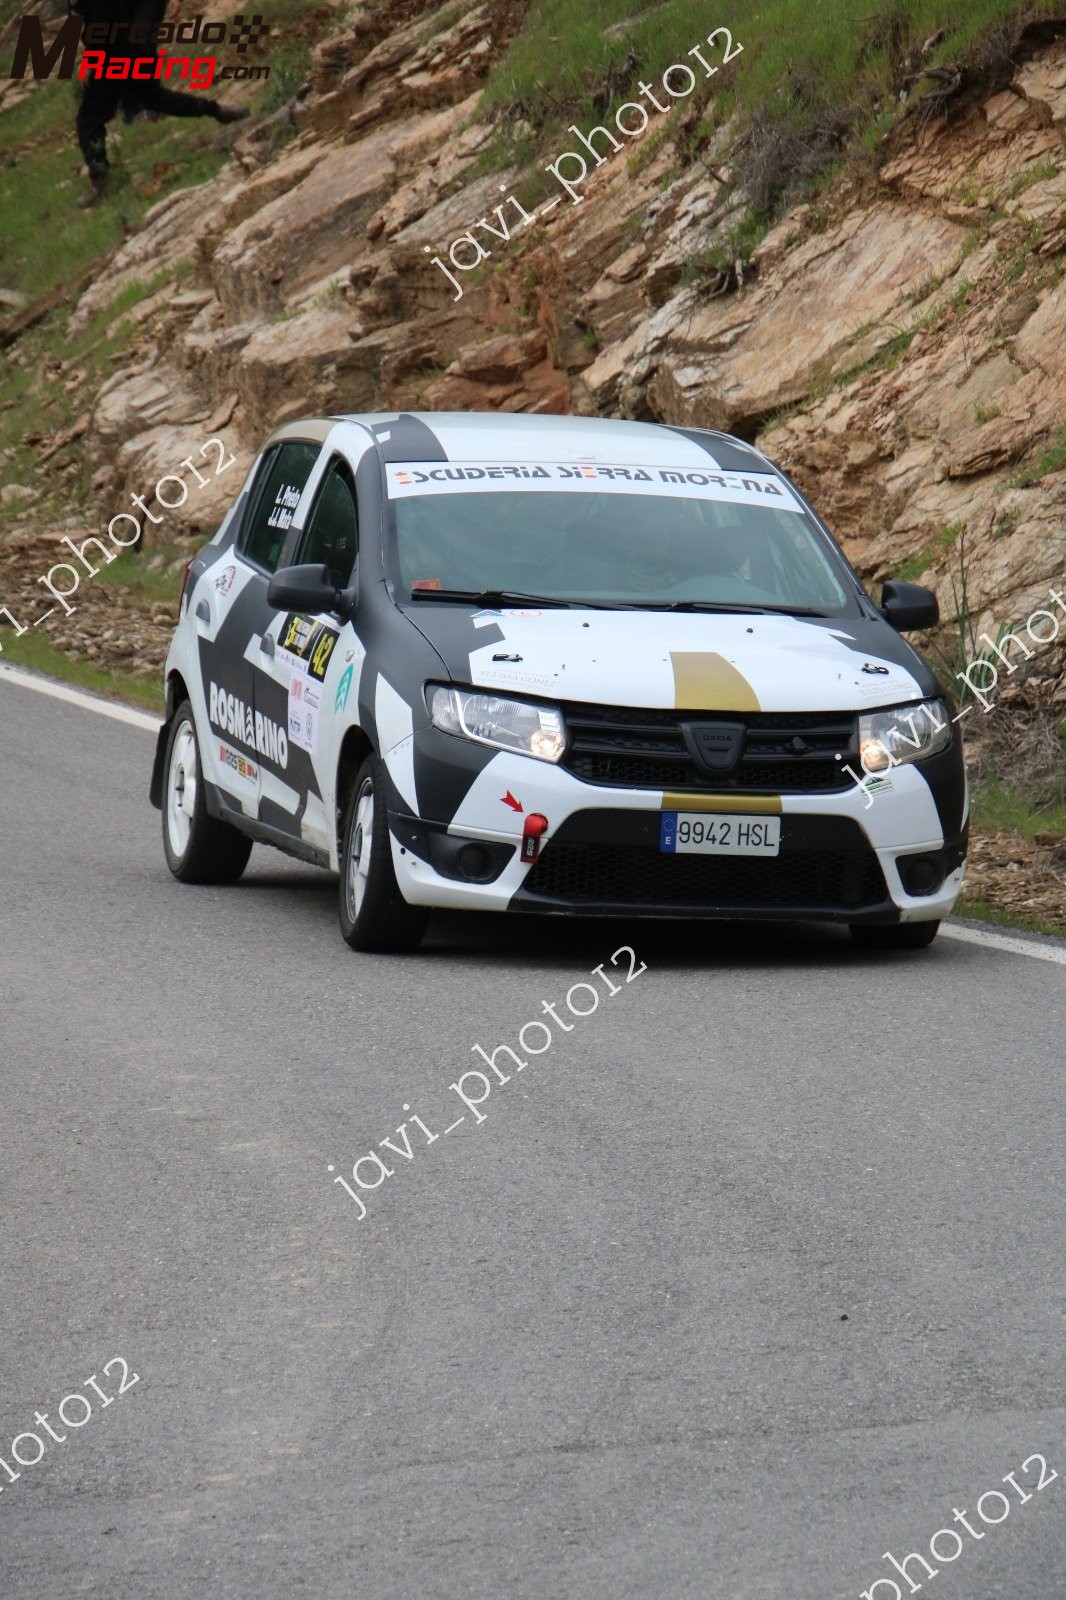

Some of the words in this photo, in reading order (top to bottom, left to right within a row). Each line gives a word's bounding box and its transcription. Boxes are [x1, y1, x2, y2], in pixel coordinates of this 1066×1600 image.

[312, 633, 335, 676] 42
[665, 836, 672, 845] E
[678, 820, 731, 845] 9942
[737, 823, 775, 847] HSL
